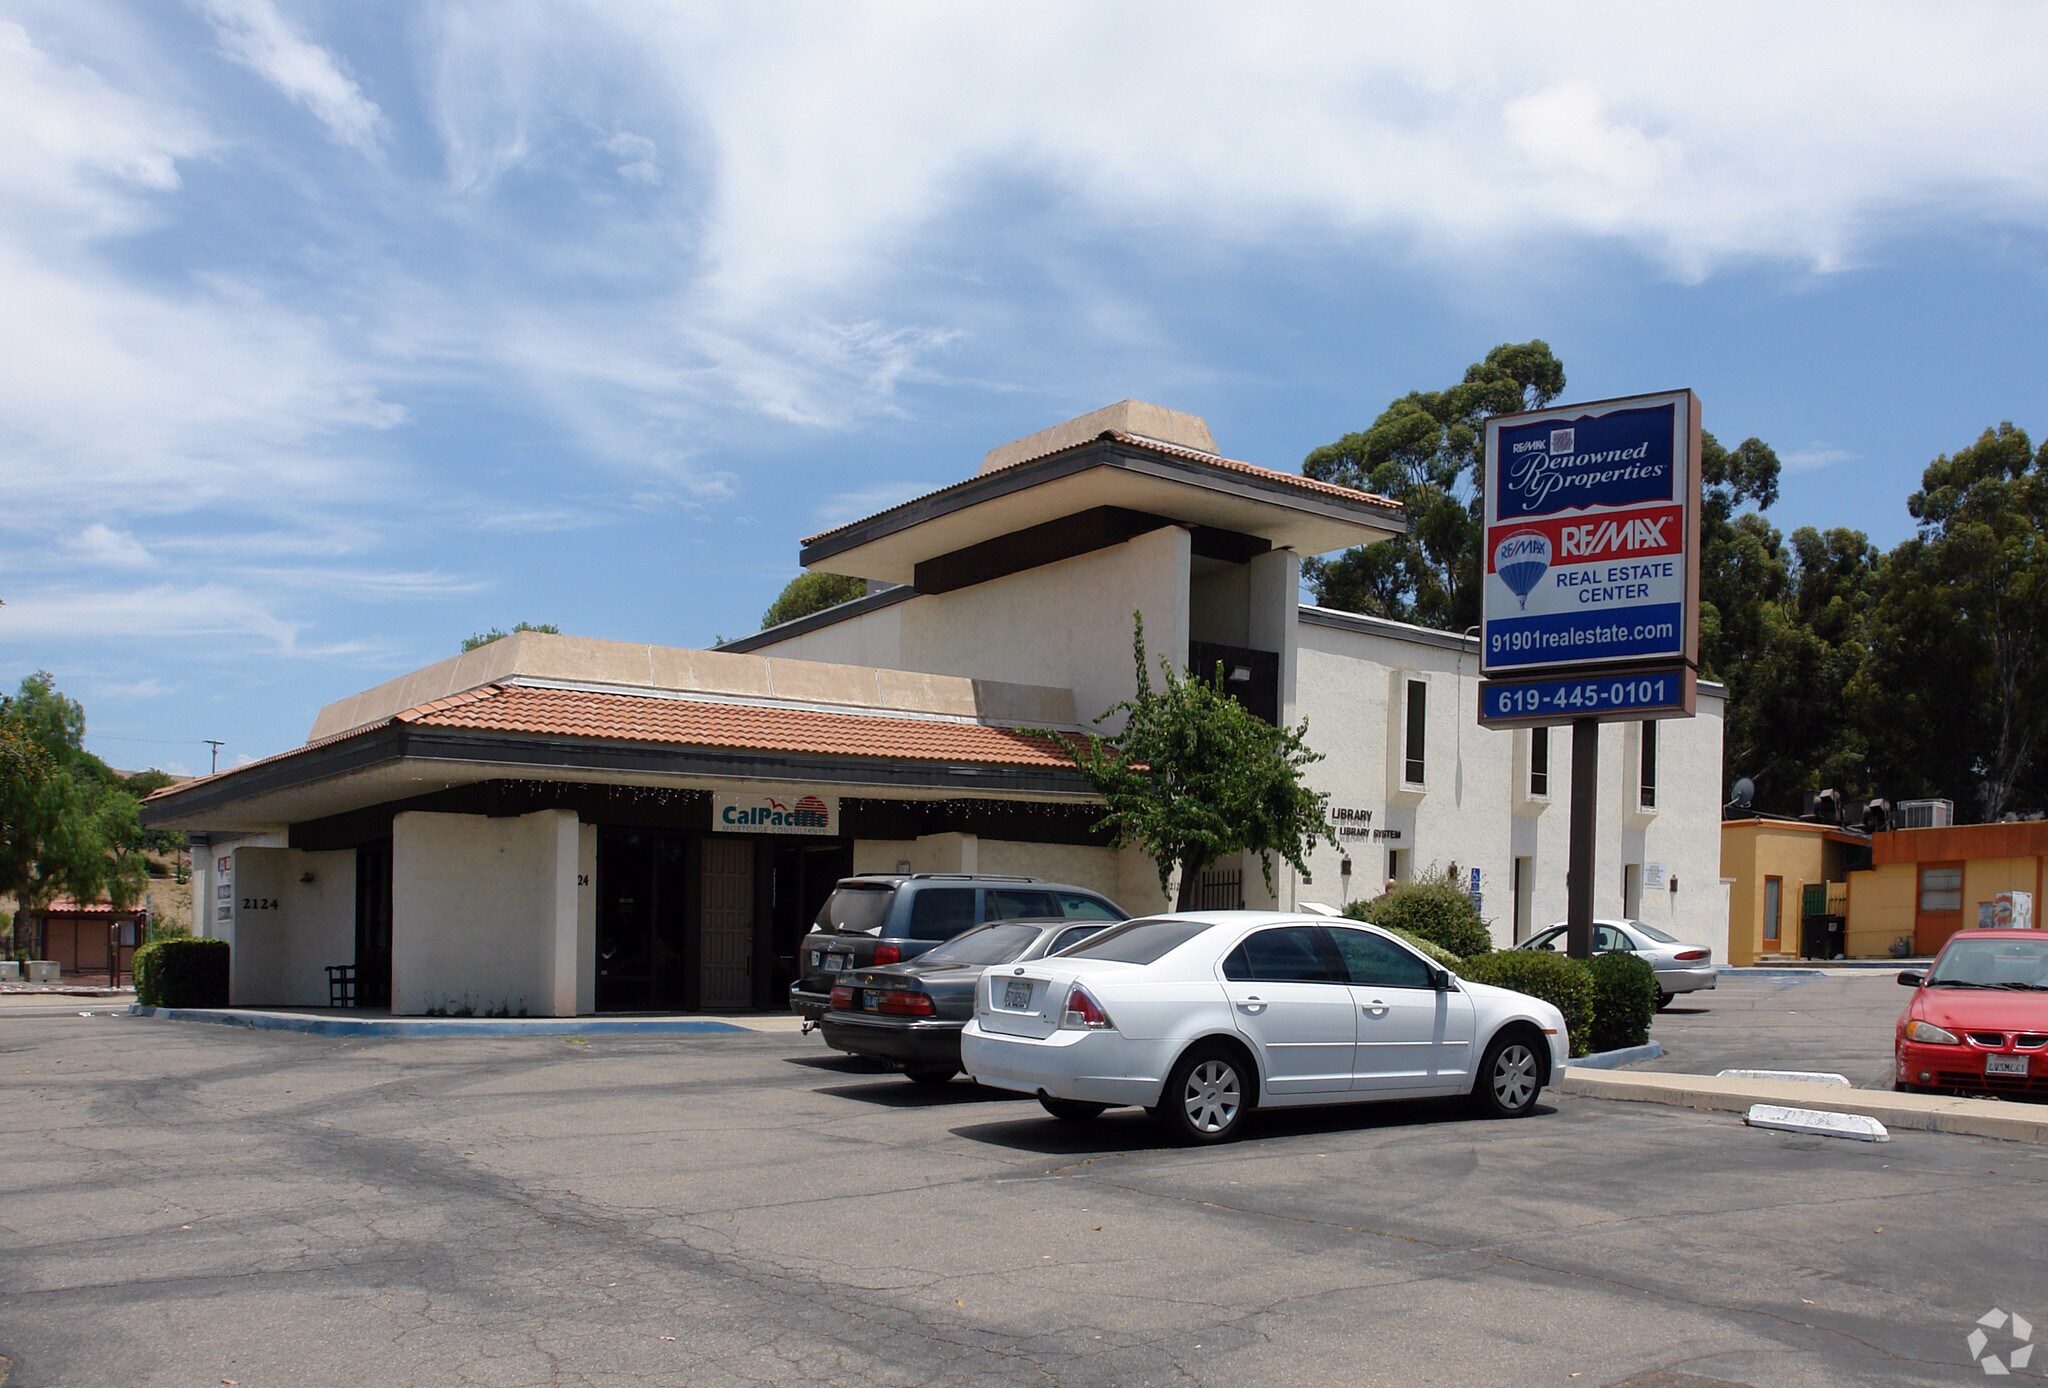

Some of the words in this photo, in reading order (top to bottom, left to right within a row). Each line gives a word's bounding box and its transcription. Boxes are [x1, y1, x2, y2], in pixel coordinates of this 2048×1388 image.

[1513, 440, 1546, 453] RE/MAX
[1509, 442, 1647, 490] Renowned
[1523, 462, 1662, 510] Properties
[1561, 516, 1667, 556] RE/MAX
[1501, 540, 1545, 559] RE/MAX
[1556, 569, 1602, 588] REAL
[1607, 562, 1673, 583] ESTATE
[1578, 583, 1649, 603] CENTER
[1492, 623, 1673, 652] 91901realestate.com
[1499, 680, 1666, 713] 619-445-0101
[1332, 808, 1372, 821] LIBRARY
[1340, 827, 1370, 837] LIBRARY
[1373, 830, 1401, 838] SYSTEM
[577, 874, 589, 887] 24
[242, 897, 279, 911] 2124
